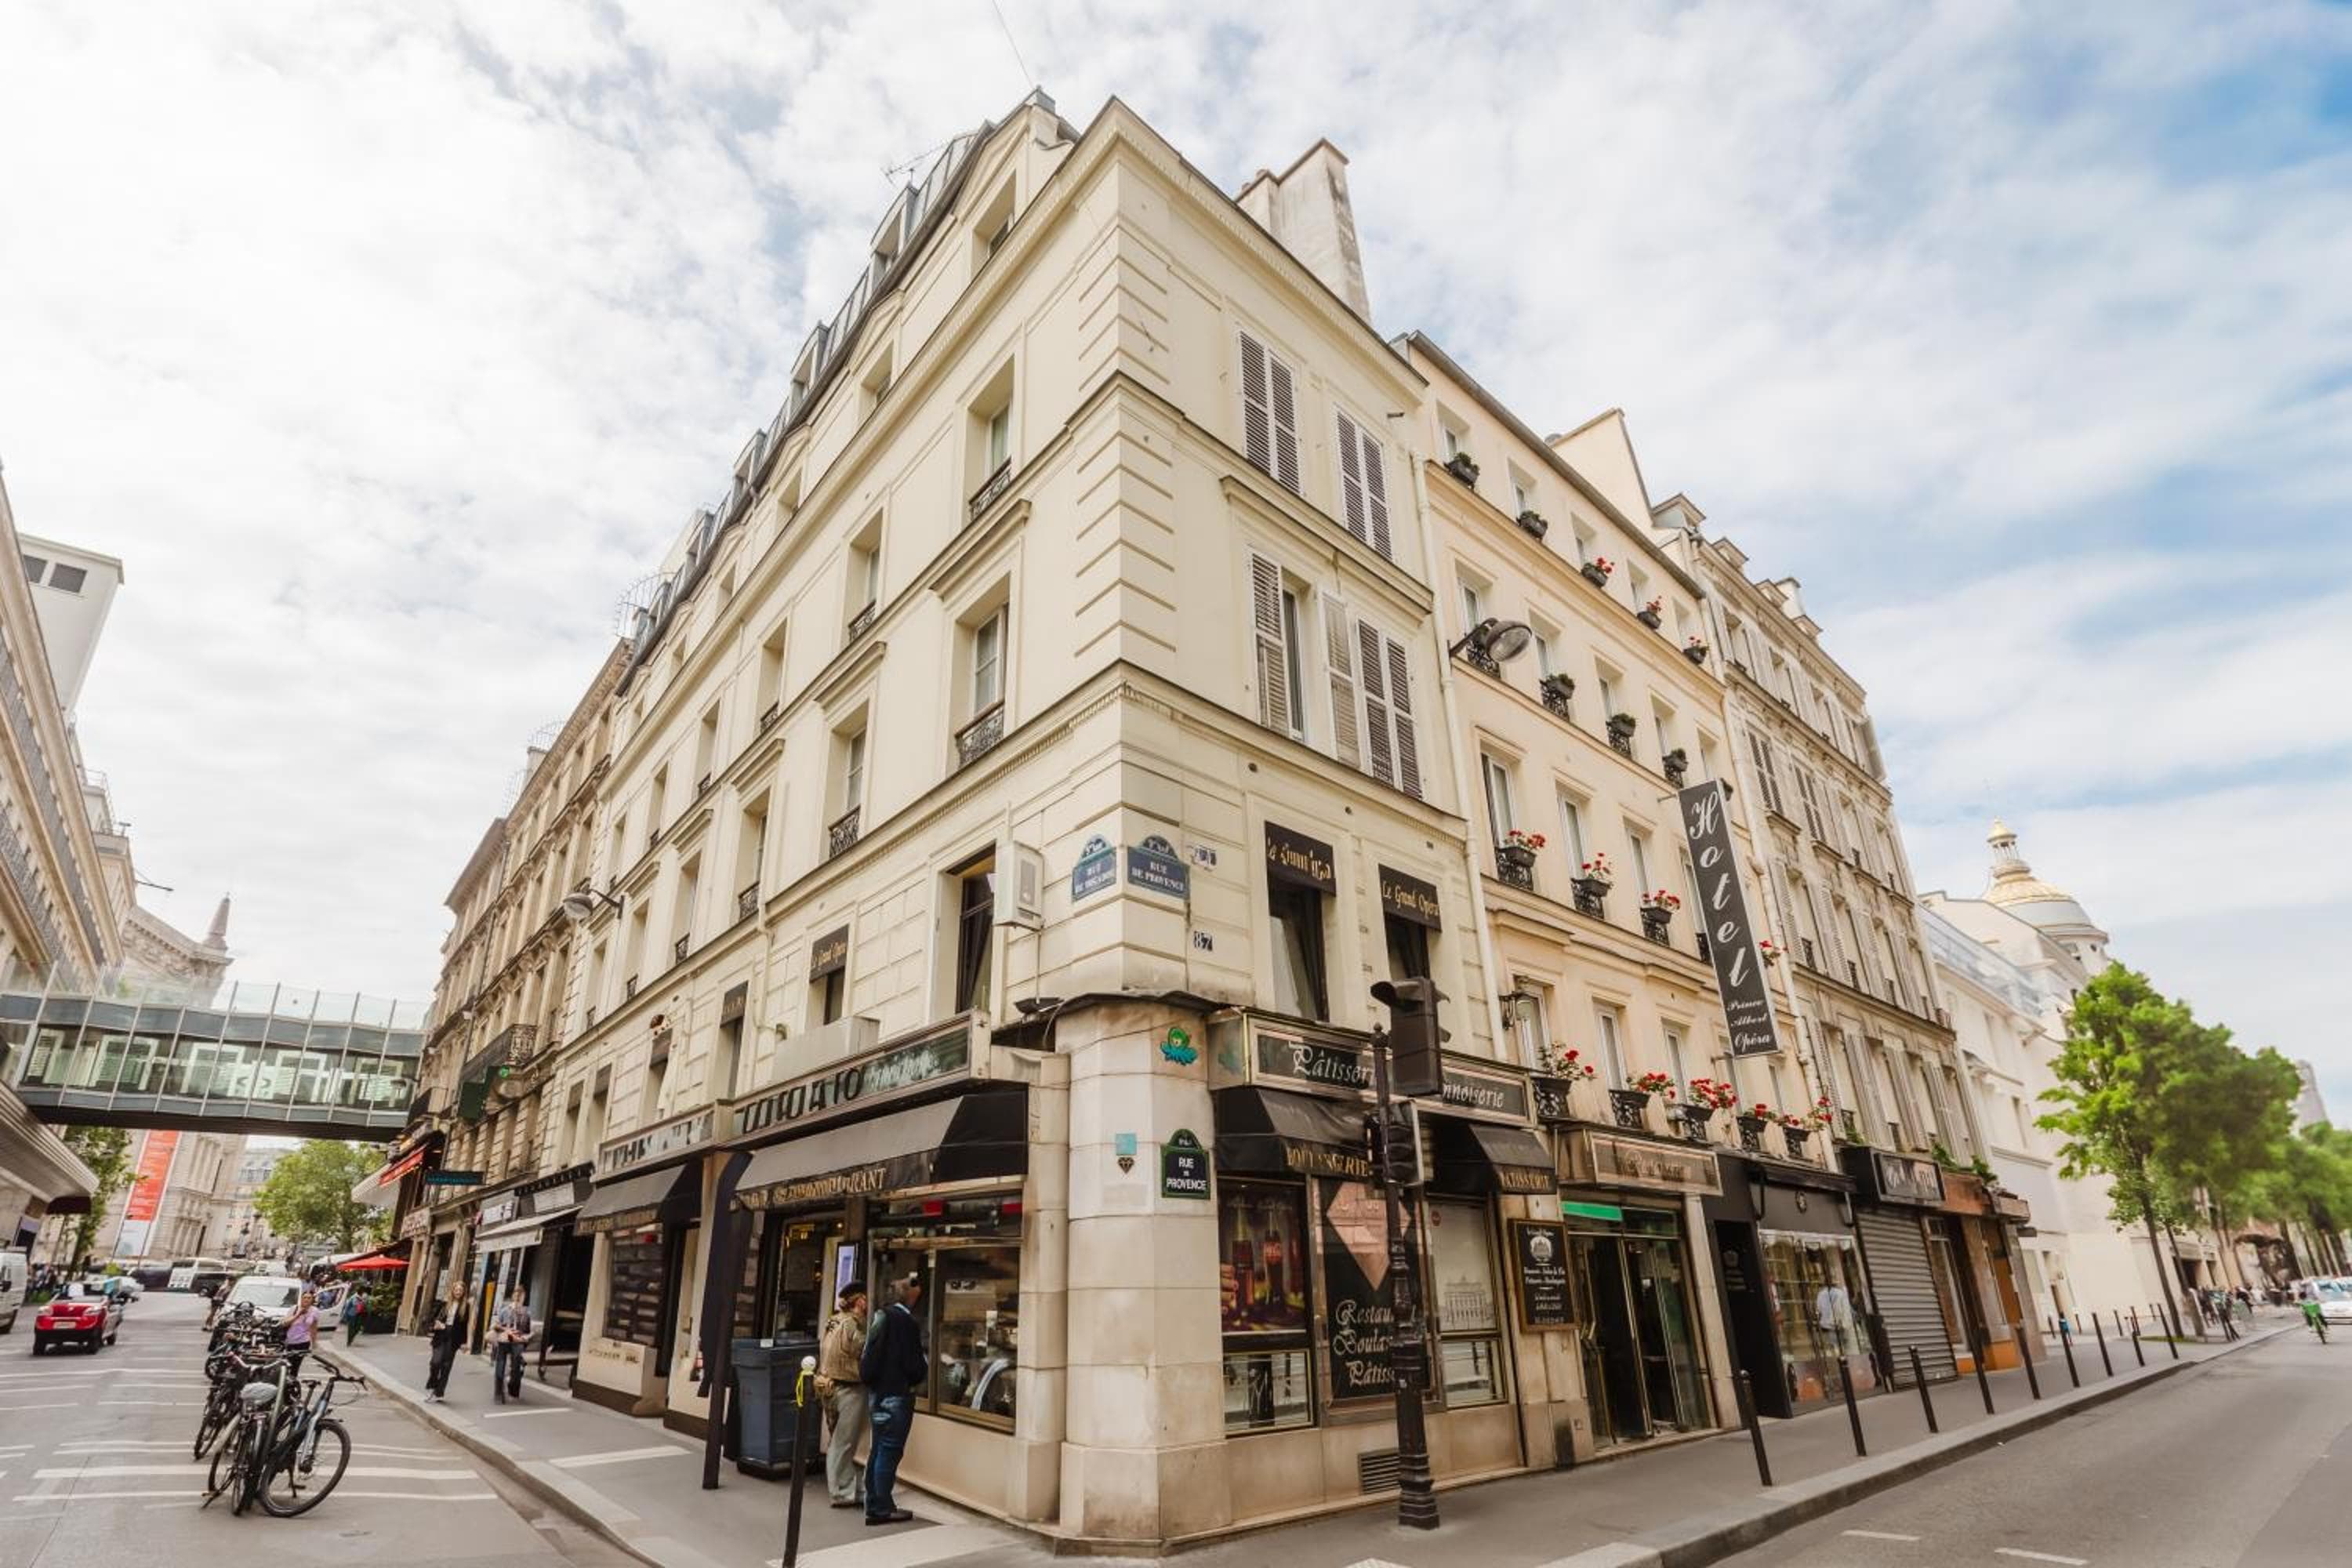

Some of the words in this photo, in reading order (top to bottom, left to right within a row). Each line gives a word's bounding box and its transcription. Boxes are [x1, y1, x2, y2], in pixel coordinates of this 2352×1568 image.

[1149, 862, 1167, 875] RUE
[1145, 870, 1185, 891] PROVENCE
[1382, 880, 1392, 899] Le
[1690, 791, 1750, 988] Hotel
[1288, 1040, 1370, 1083] Pâtisser
[1443, 1080, 1504, 1108] nnoiserie
[1178, 1156, 1194, 1169] RUE
[1166, 1178, 1207, 1190] PROVENCE
[1335, 1299, 1417, 1326] Restaut
